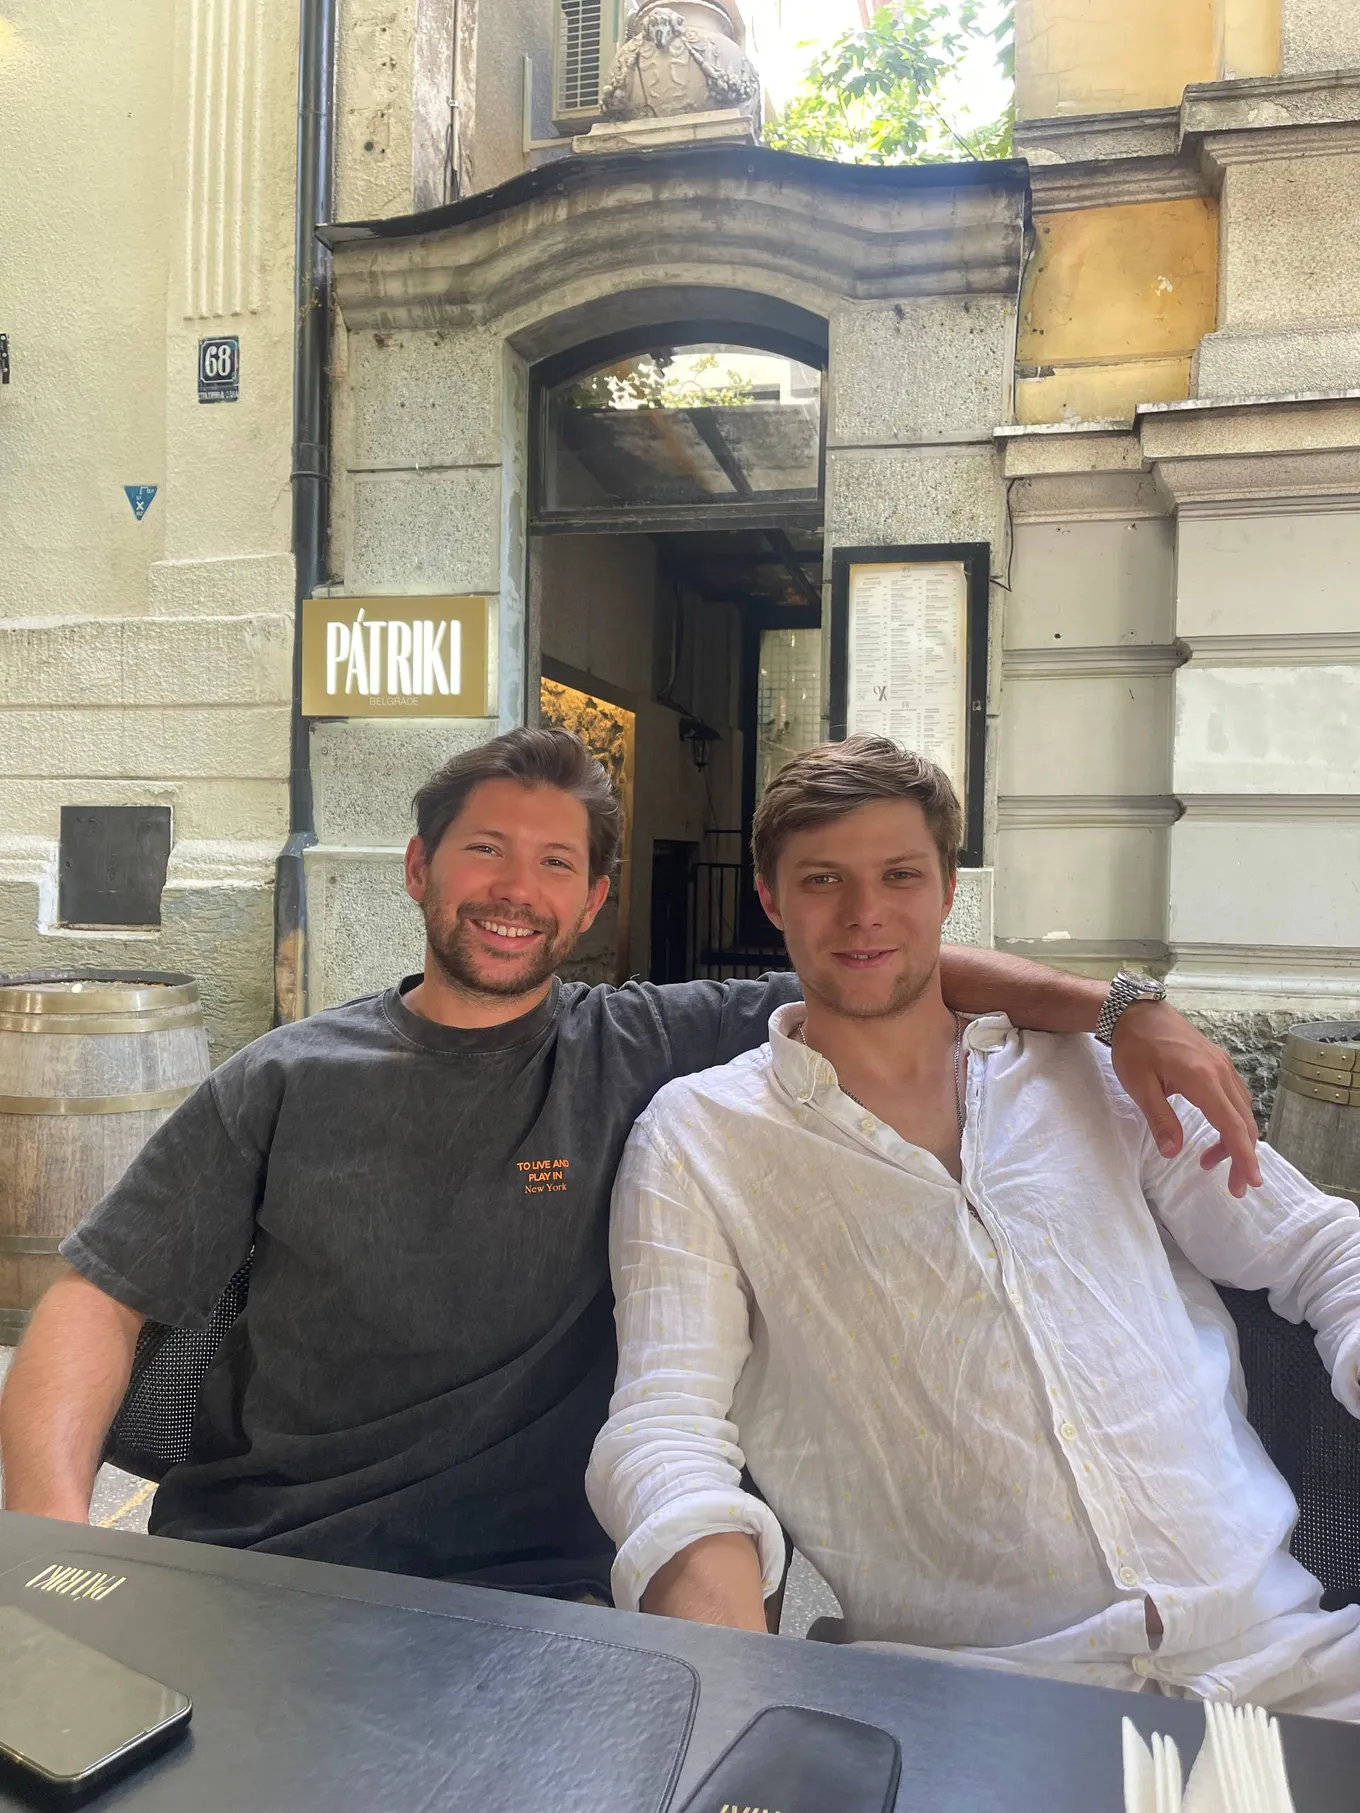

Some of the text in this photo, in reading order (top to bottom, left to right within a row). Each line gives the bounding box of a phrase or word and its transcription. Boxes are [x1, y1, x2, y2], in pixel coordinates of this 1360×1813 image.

[205, 344, 231, 377] 68
[326, 607, 461, 696] PÁTRIKI
[369, 696, 420, 706] BELGRADE
[517, 1159, 569, 1171] TO LIVE AND
[529, 1171, 562, 1182] PLAY IN
[525, 1183, 566, 1194] New York
[24, 1564, 127, 1601] PÁTRIKI
